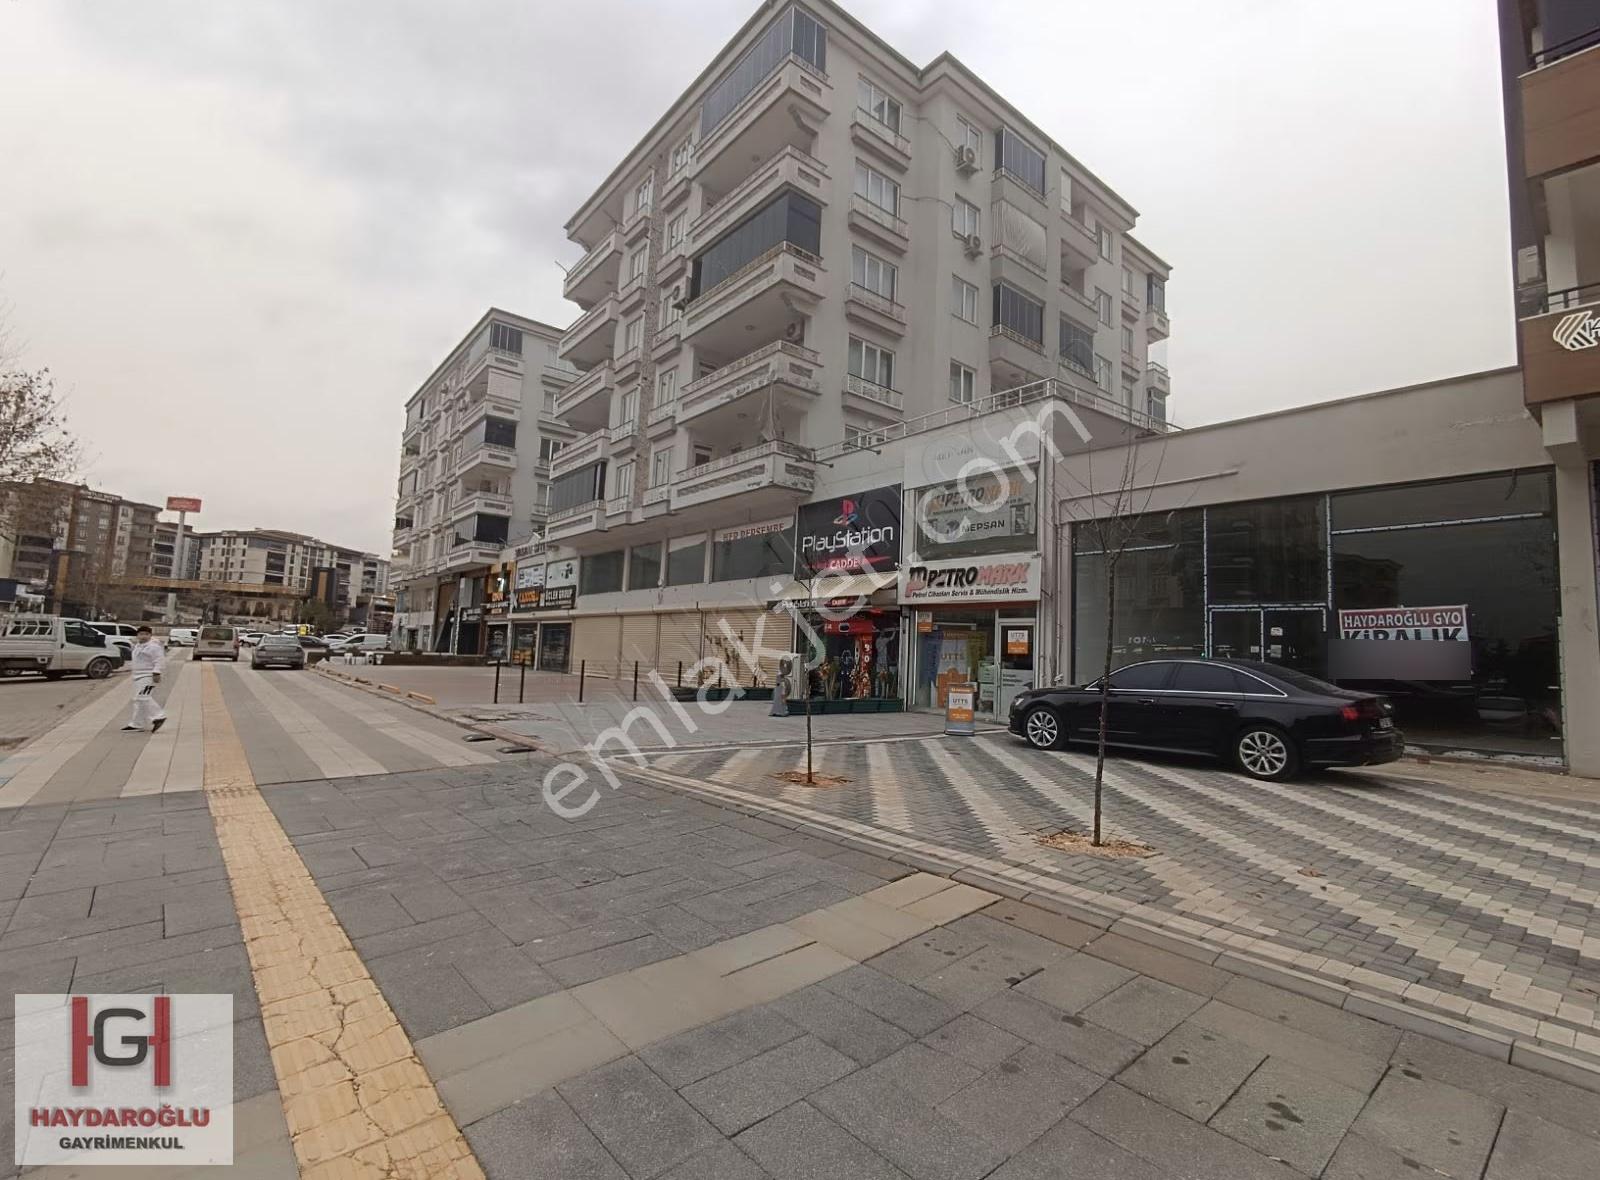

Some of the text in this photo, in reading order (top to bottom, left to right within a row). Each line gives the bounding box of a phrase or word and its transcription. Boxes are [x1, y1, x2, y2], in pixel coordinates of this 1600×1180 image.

[802, 526, 894, 553] PlayStation
[975, 587, 1010, 596] Mühendislik
[1344, 611, 1462, 627] HAYDAROĞLU GYO
